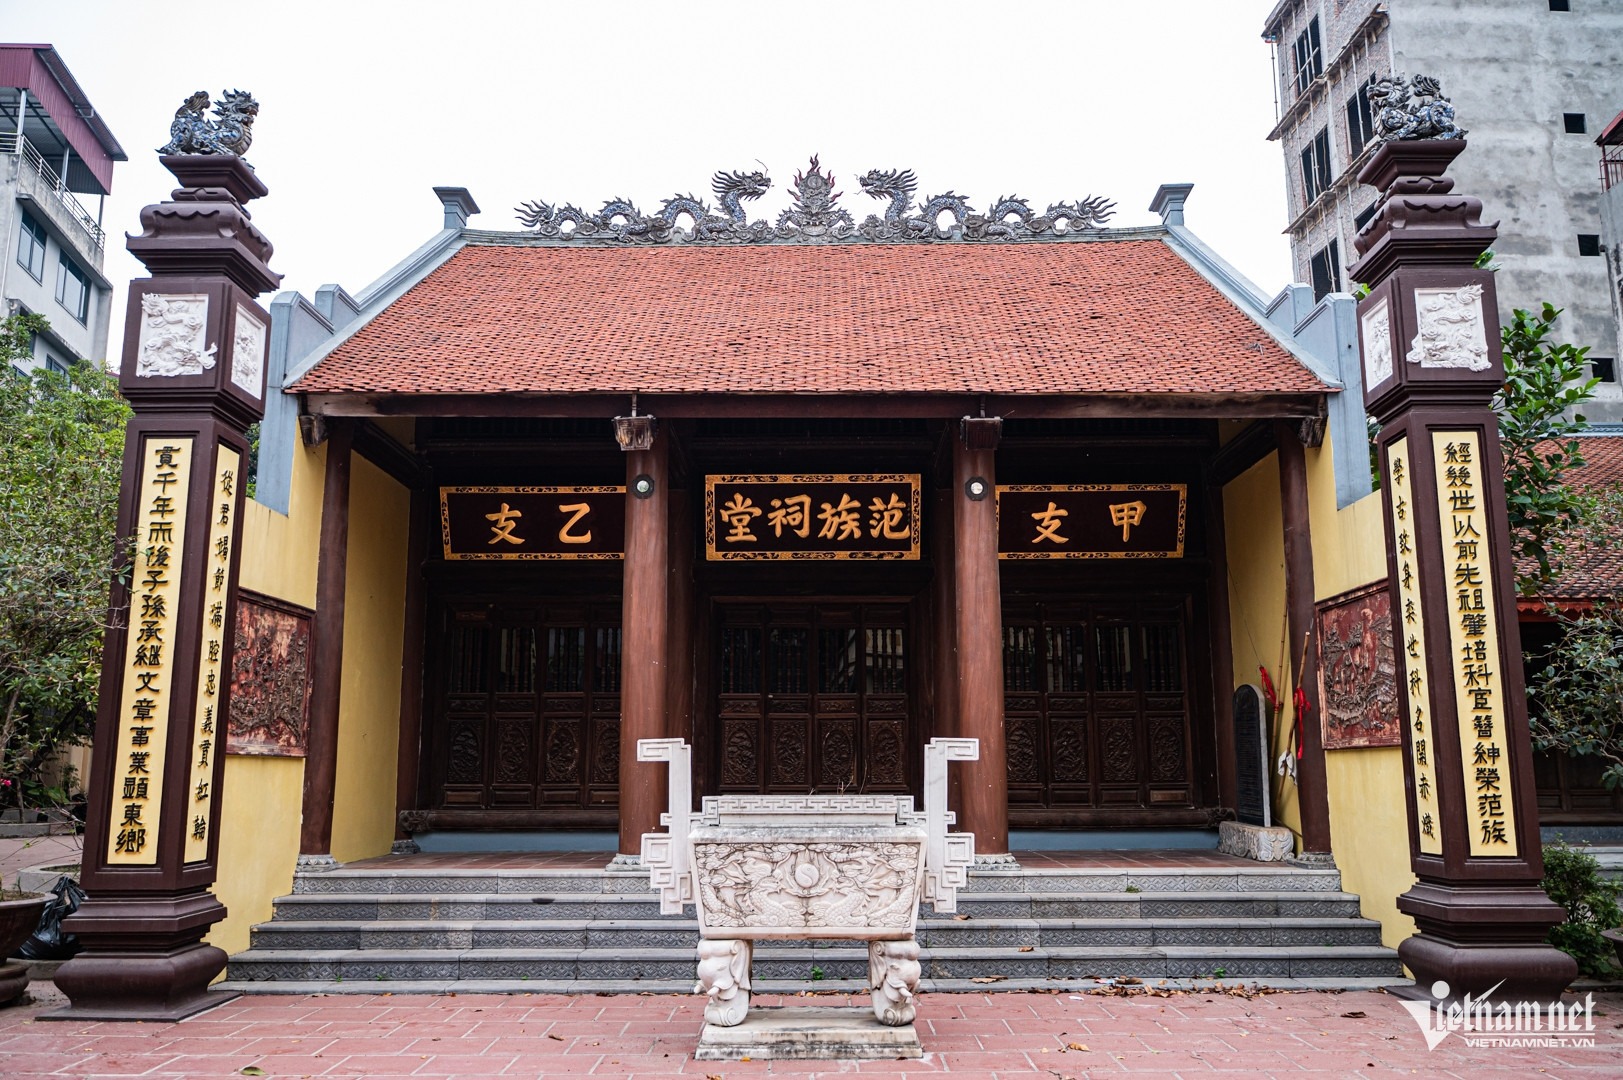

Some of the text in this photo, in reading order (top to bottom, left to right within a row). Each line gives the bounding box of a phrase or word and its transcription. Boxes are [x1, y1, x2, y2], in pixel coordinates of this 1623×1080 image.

[485, 502, 592, 544] 乙支
[719, 492, 911, 542] 范族祠堂
[1031, 500, 1147, 544] 甲支
